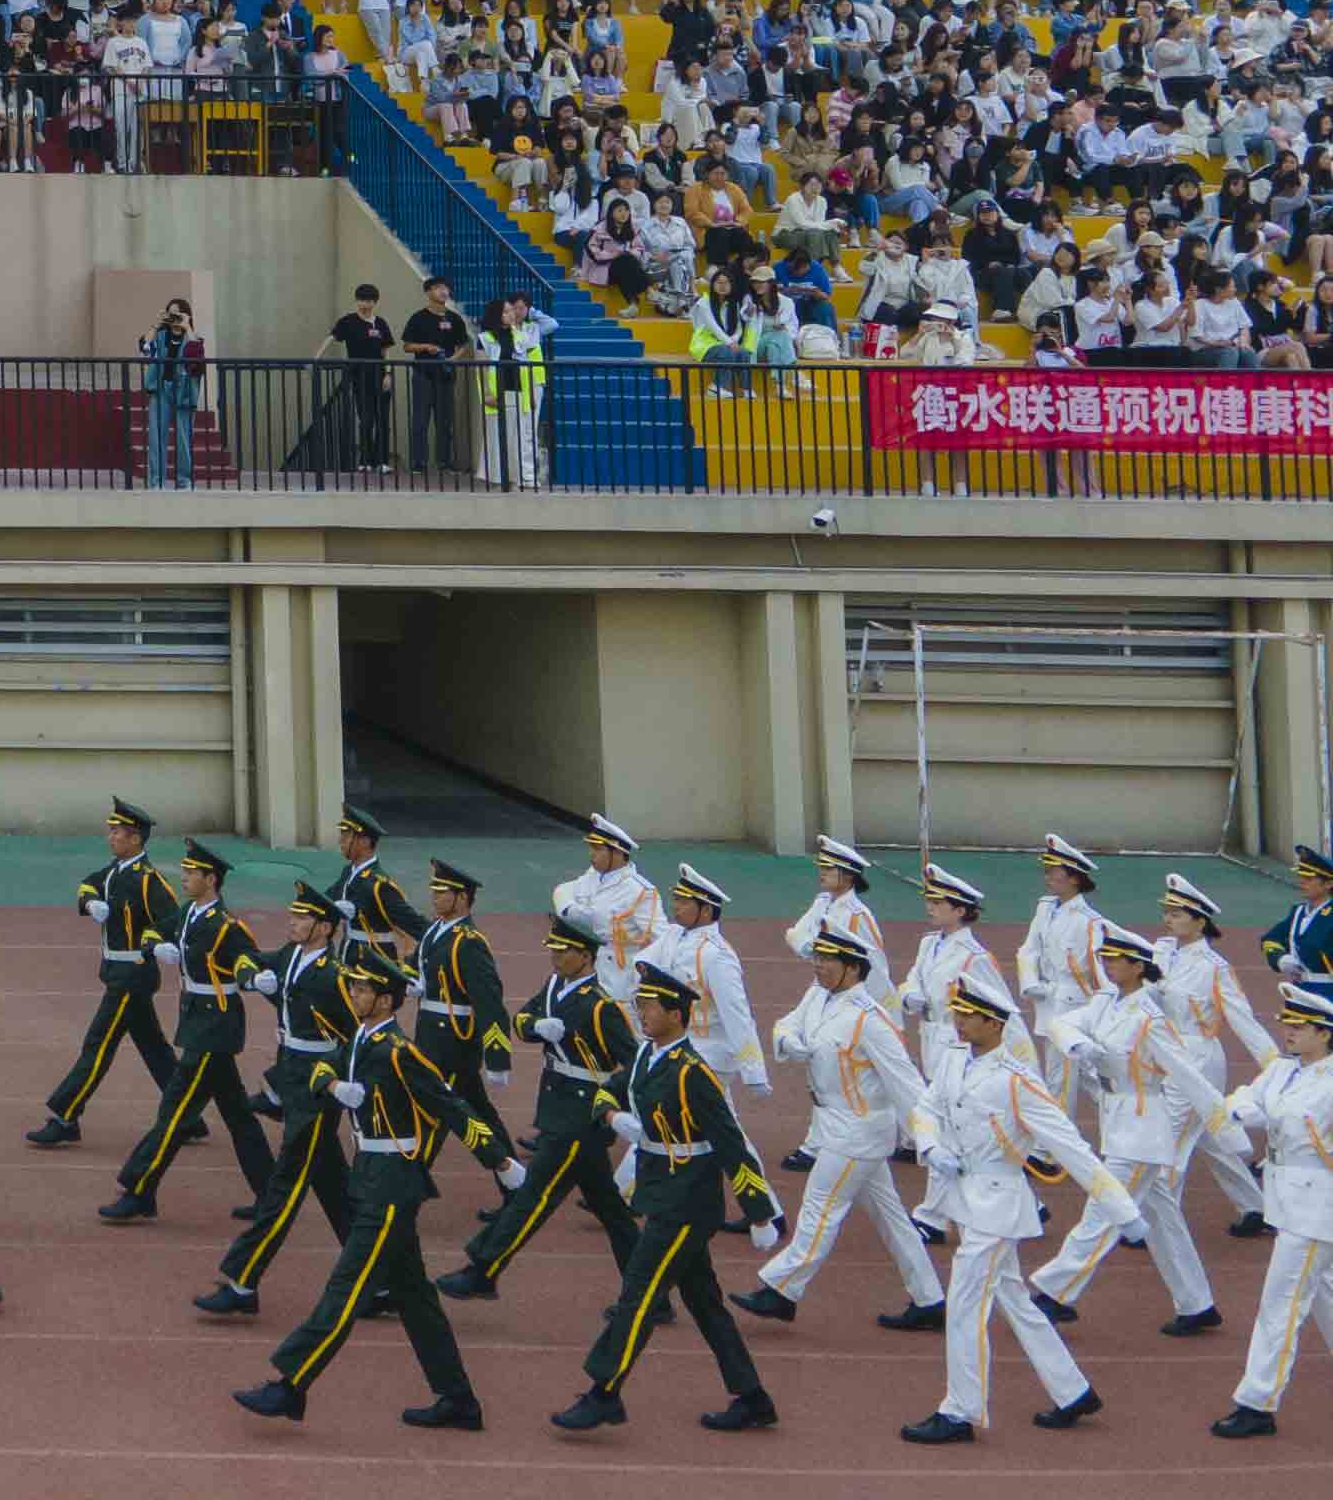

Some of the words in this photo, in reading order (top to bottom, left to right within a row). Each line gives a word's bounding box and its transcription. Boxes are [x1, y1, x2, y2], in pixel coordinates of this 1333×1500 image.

[911, 384, 1333, 436] 衡水联通预祝健康科
